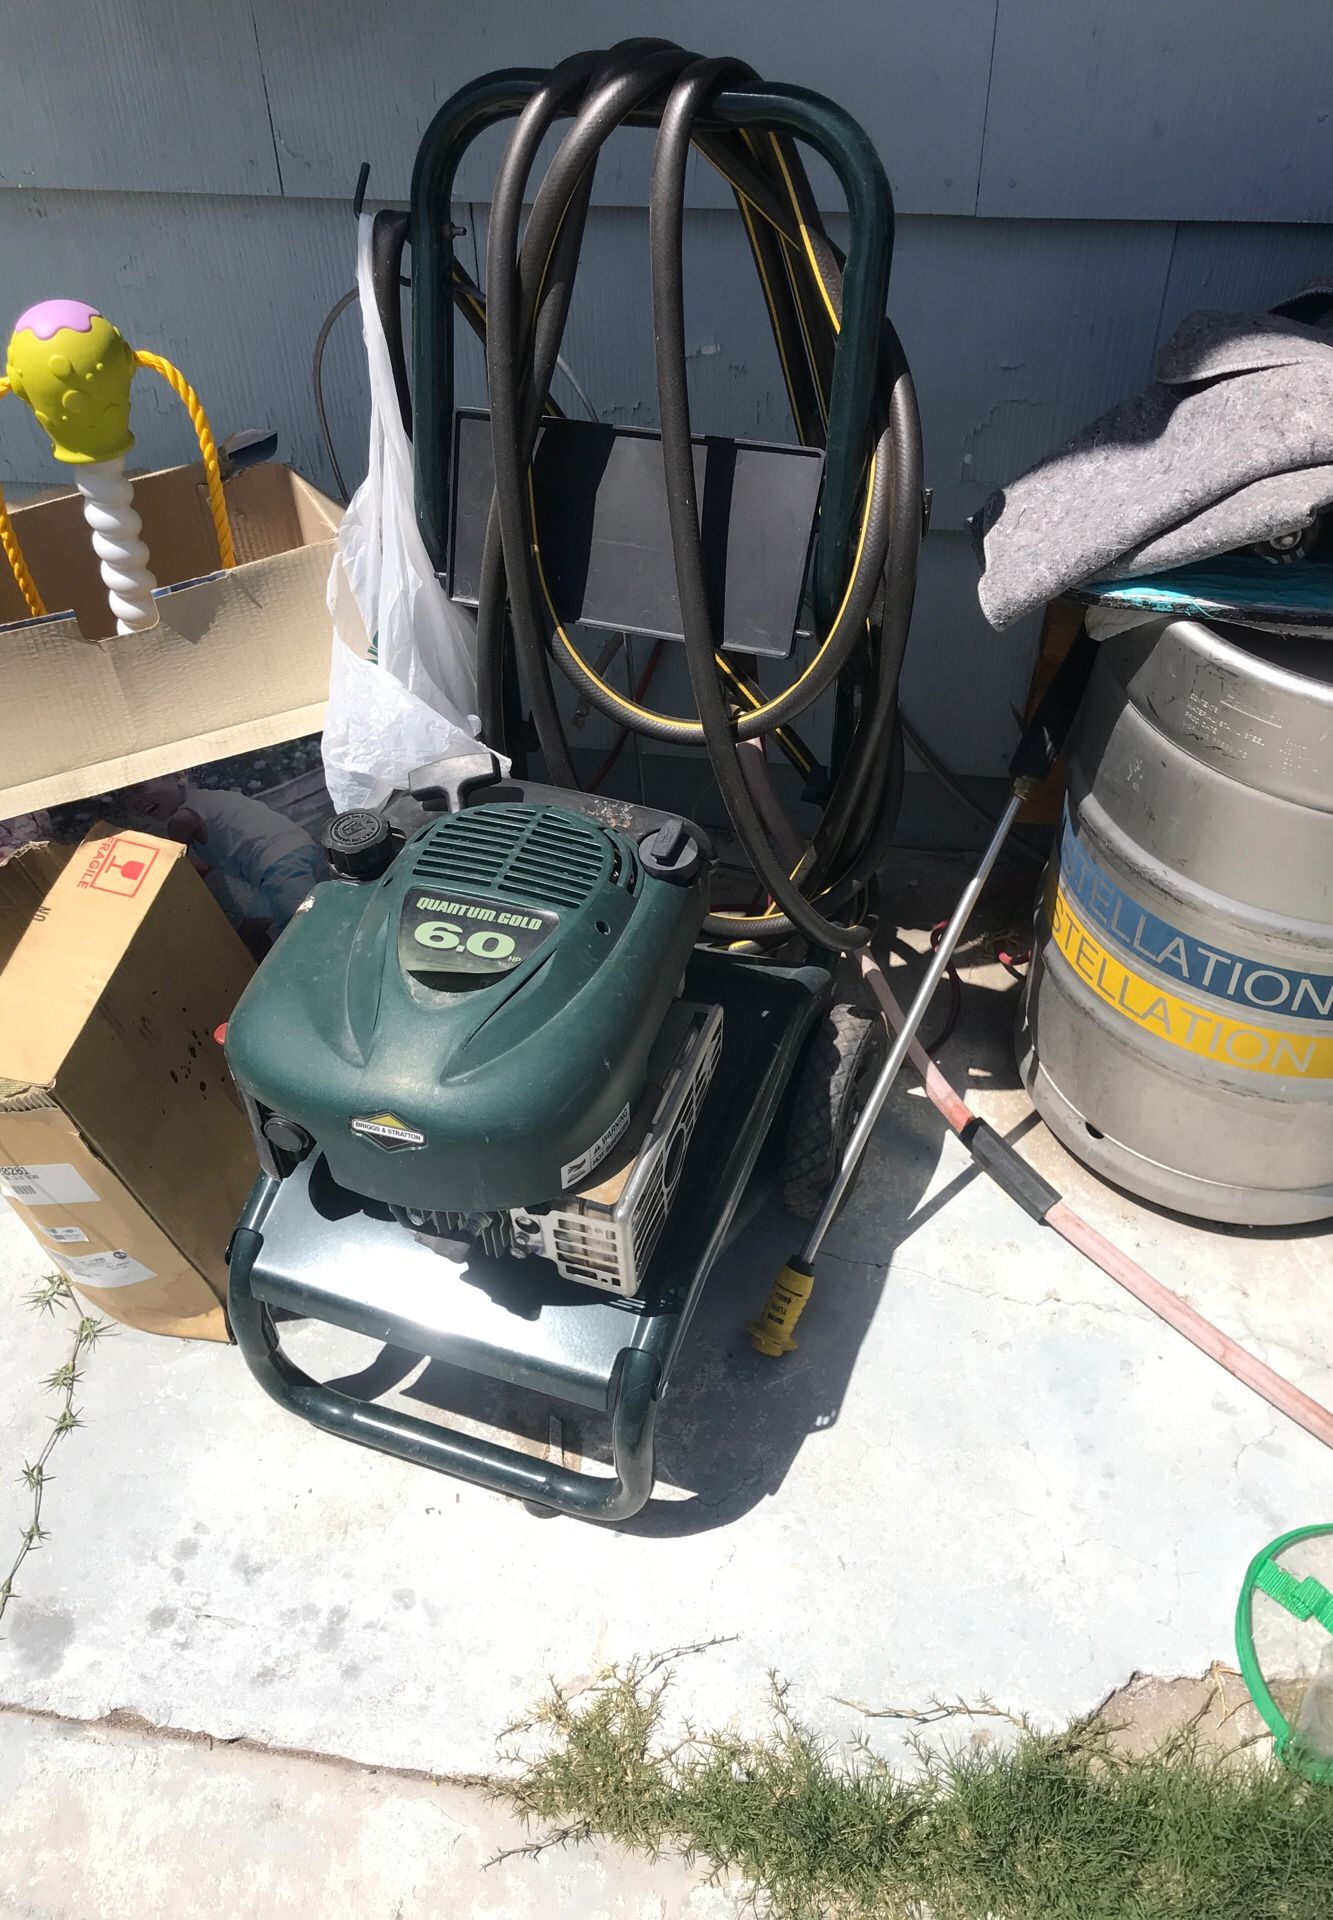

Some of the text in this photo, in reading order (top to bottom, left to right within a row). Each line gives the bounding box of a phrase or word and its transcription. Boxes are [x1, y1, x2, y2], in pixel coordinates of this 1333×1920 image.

[76, 836, 115, 890] FRAGILE
[416, 897, 543, 930] QUANTUM GOLD
[414, 920, 516, 959] 6.0
[507, 955, 522, 963] HP
[355, 1120, 380, 1133] BRIGGS
[387, 1128, 421, 1141] STRATTON
[601, 1107, 629, 1145] WARNING
